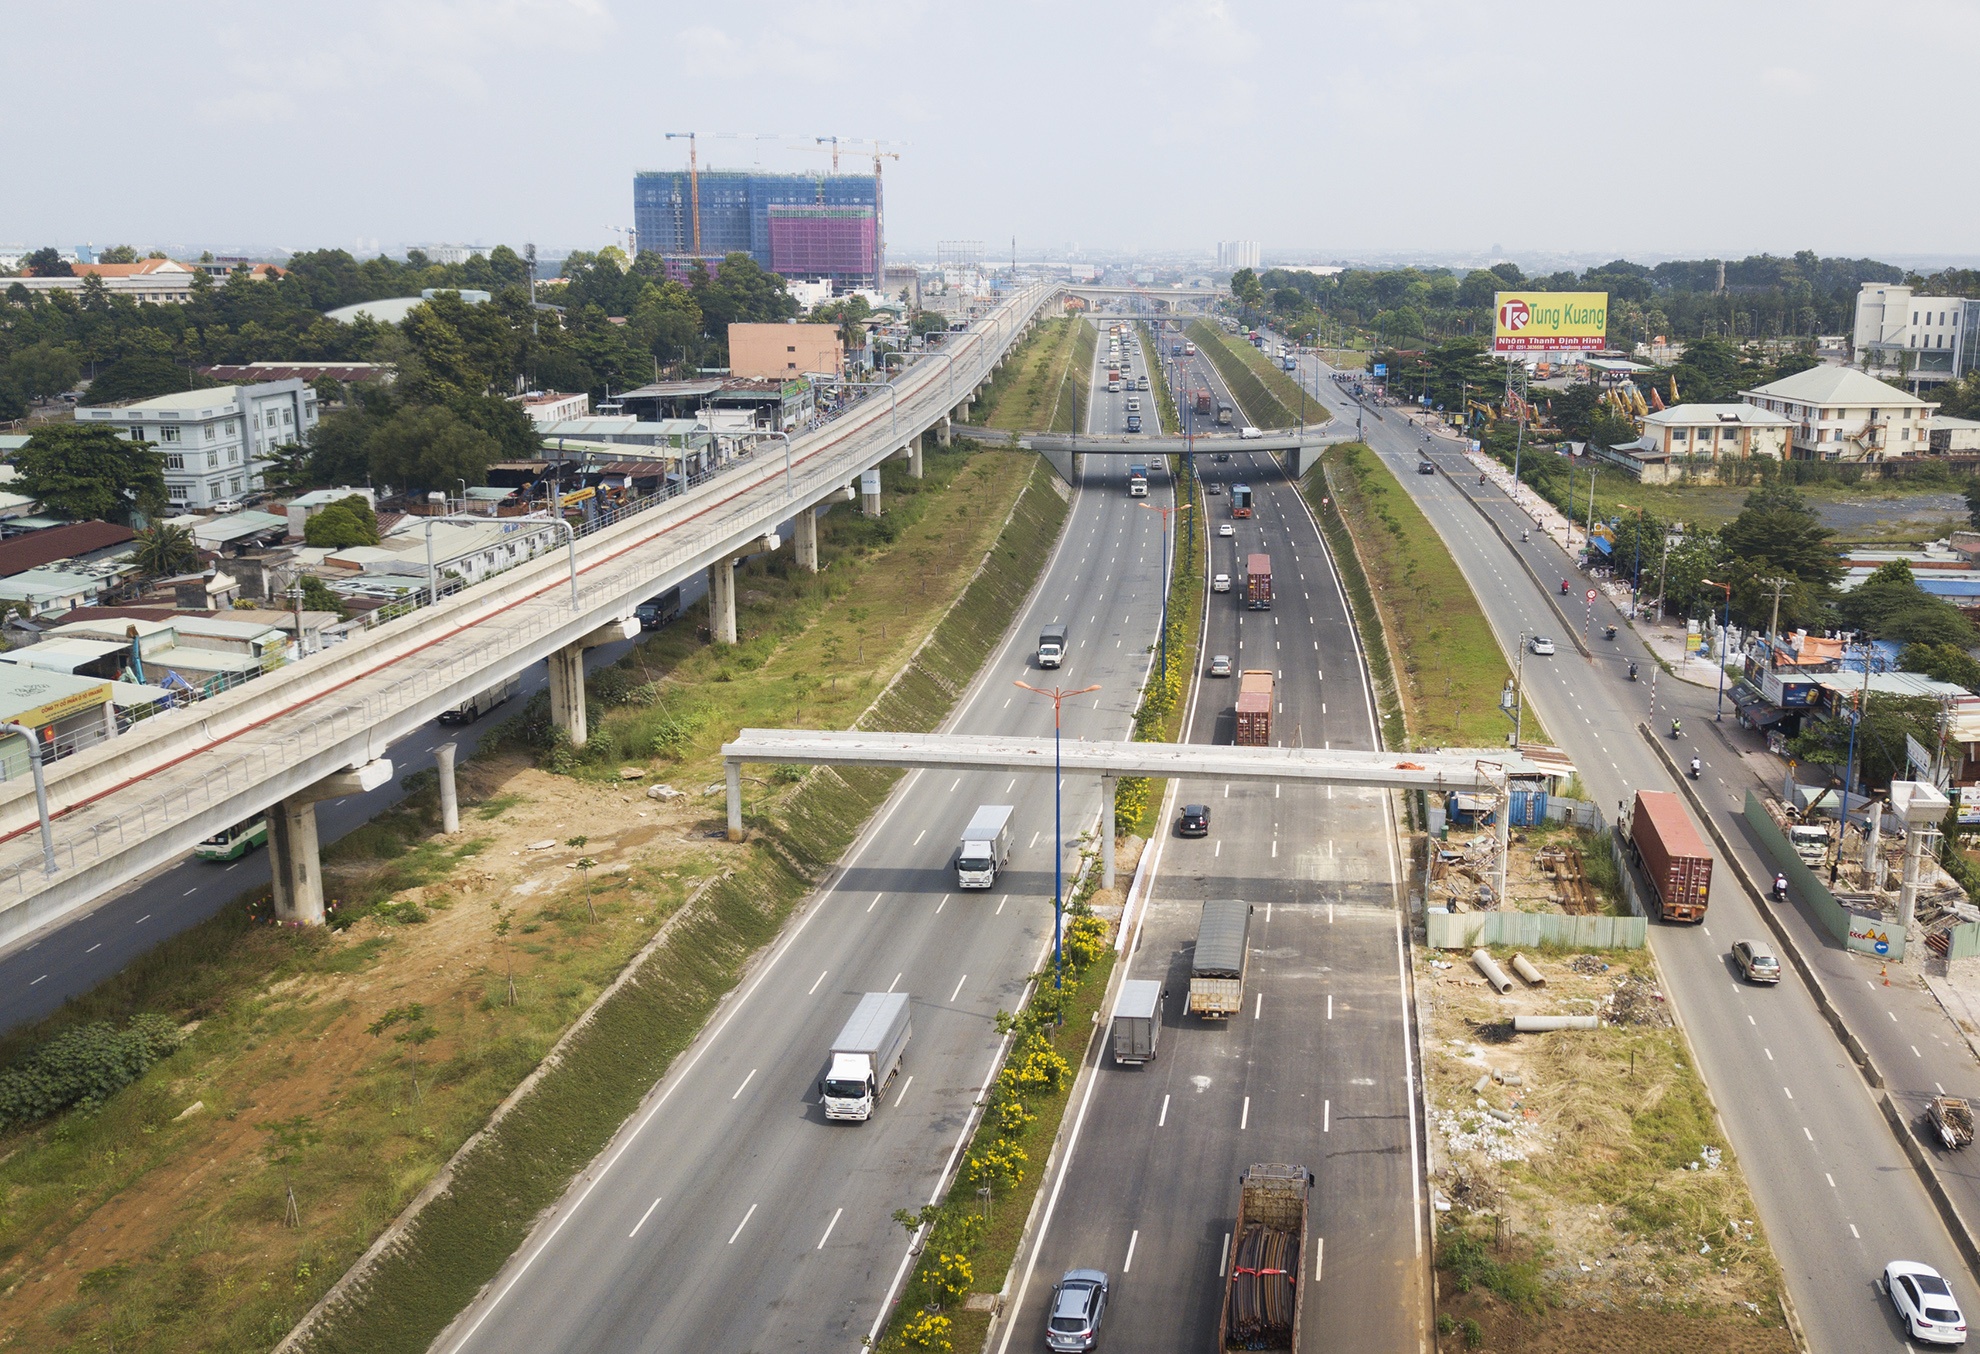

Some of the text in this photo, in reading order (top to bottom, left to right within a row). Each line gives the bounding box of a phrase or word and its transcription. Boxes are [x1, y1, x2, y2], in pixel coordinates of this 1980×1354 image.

[1529, 303, 1605, 330] Tung Kuang
[1558, 337, 1579, 345] Định
